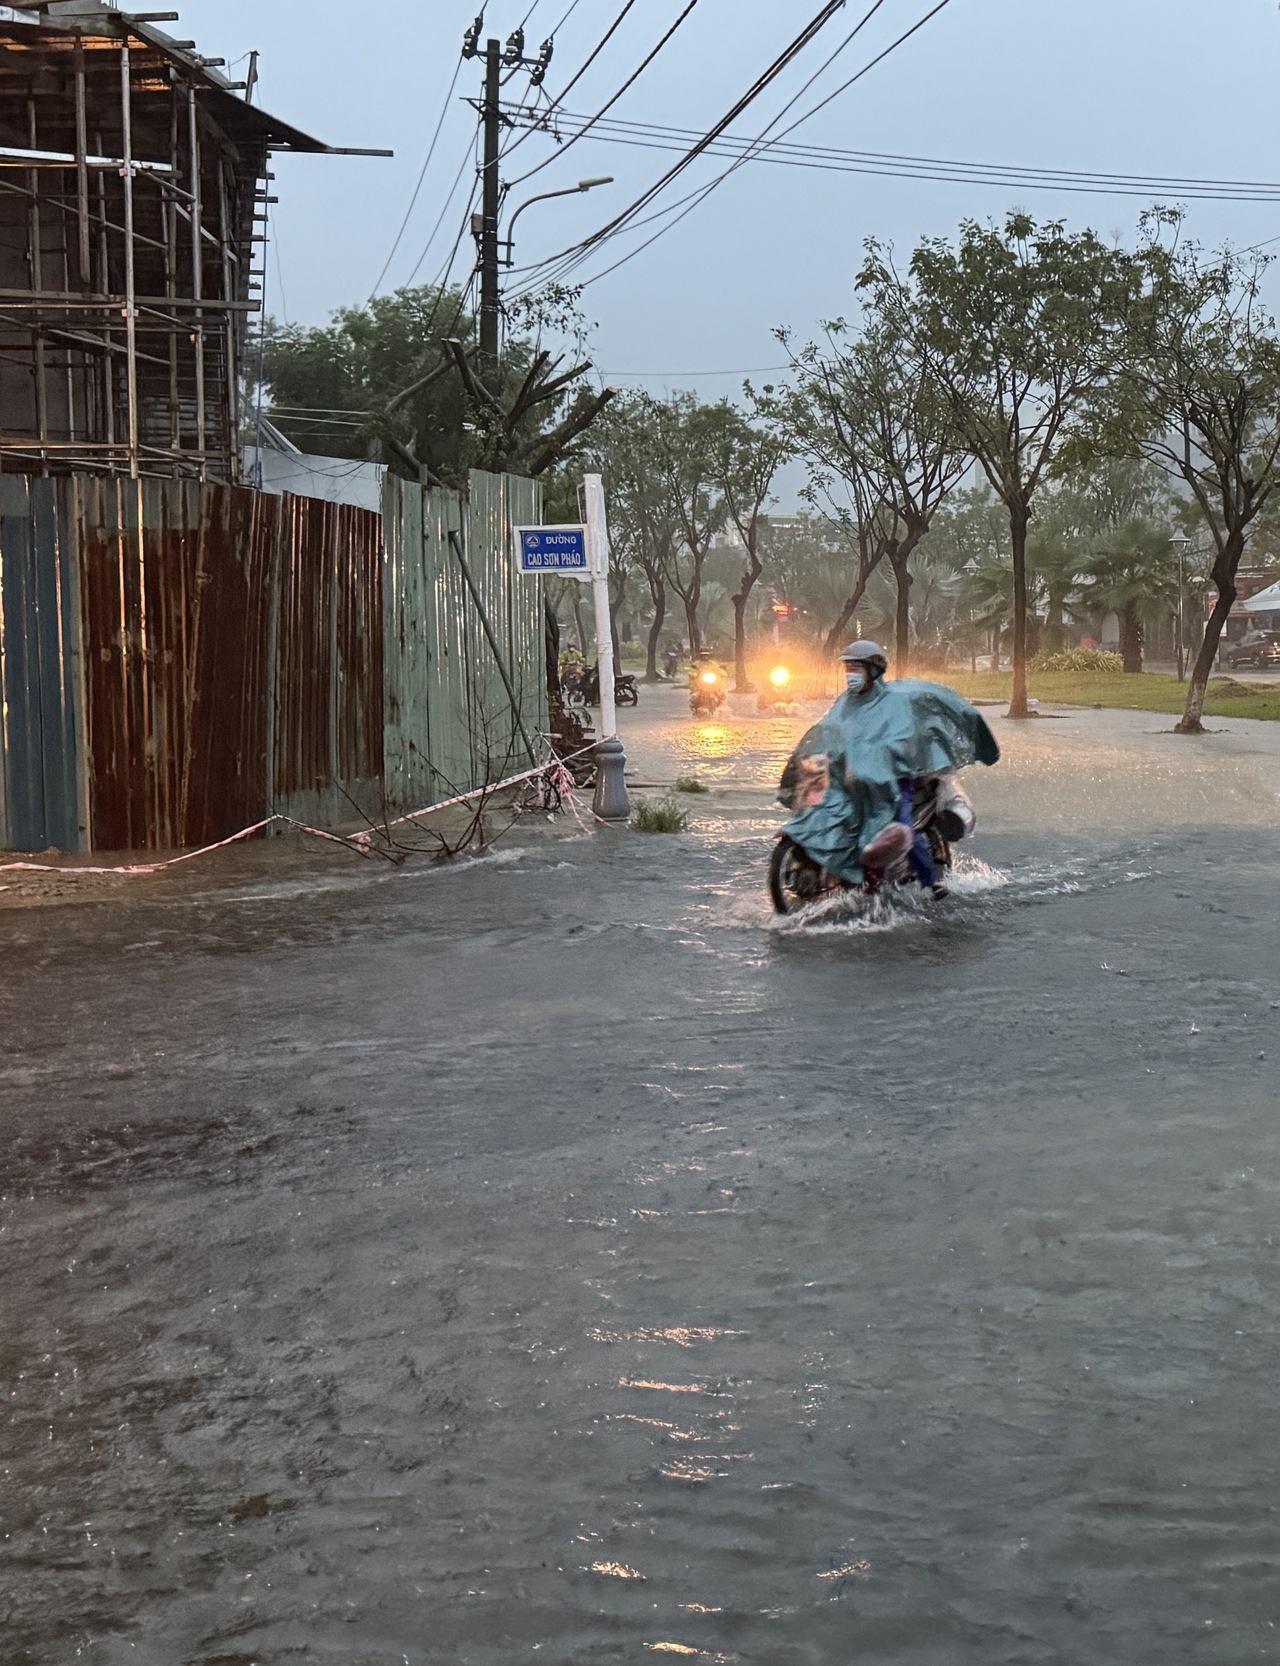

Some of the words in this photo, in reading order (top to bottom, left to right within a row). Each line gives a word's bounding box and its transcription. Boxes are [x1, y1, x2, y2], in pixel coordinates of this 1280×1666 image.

[545, 533, 577, 545] ĐƯỜNG
[527, 553, 542, 566] CAO
[543, 553, 560, 566] SƠN
[561, 549, 581, 566] PHÁO
